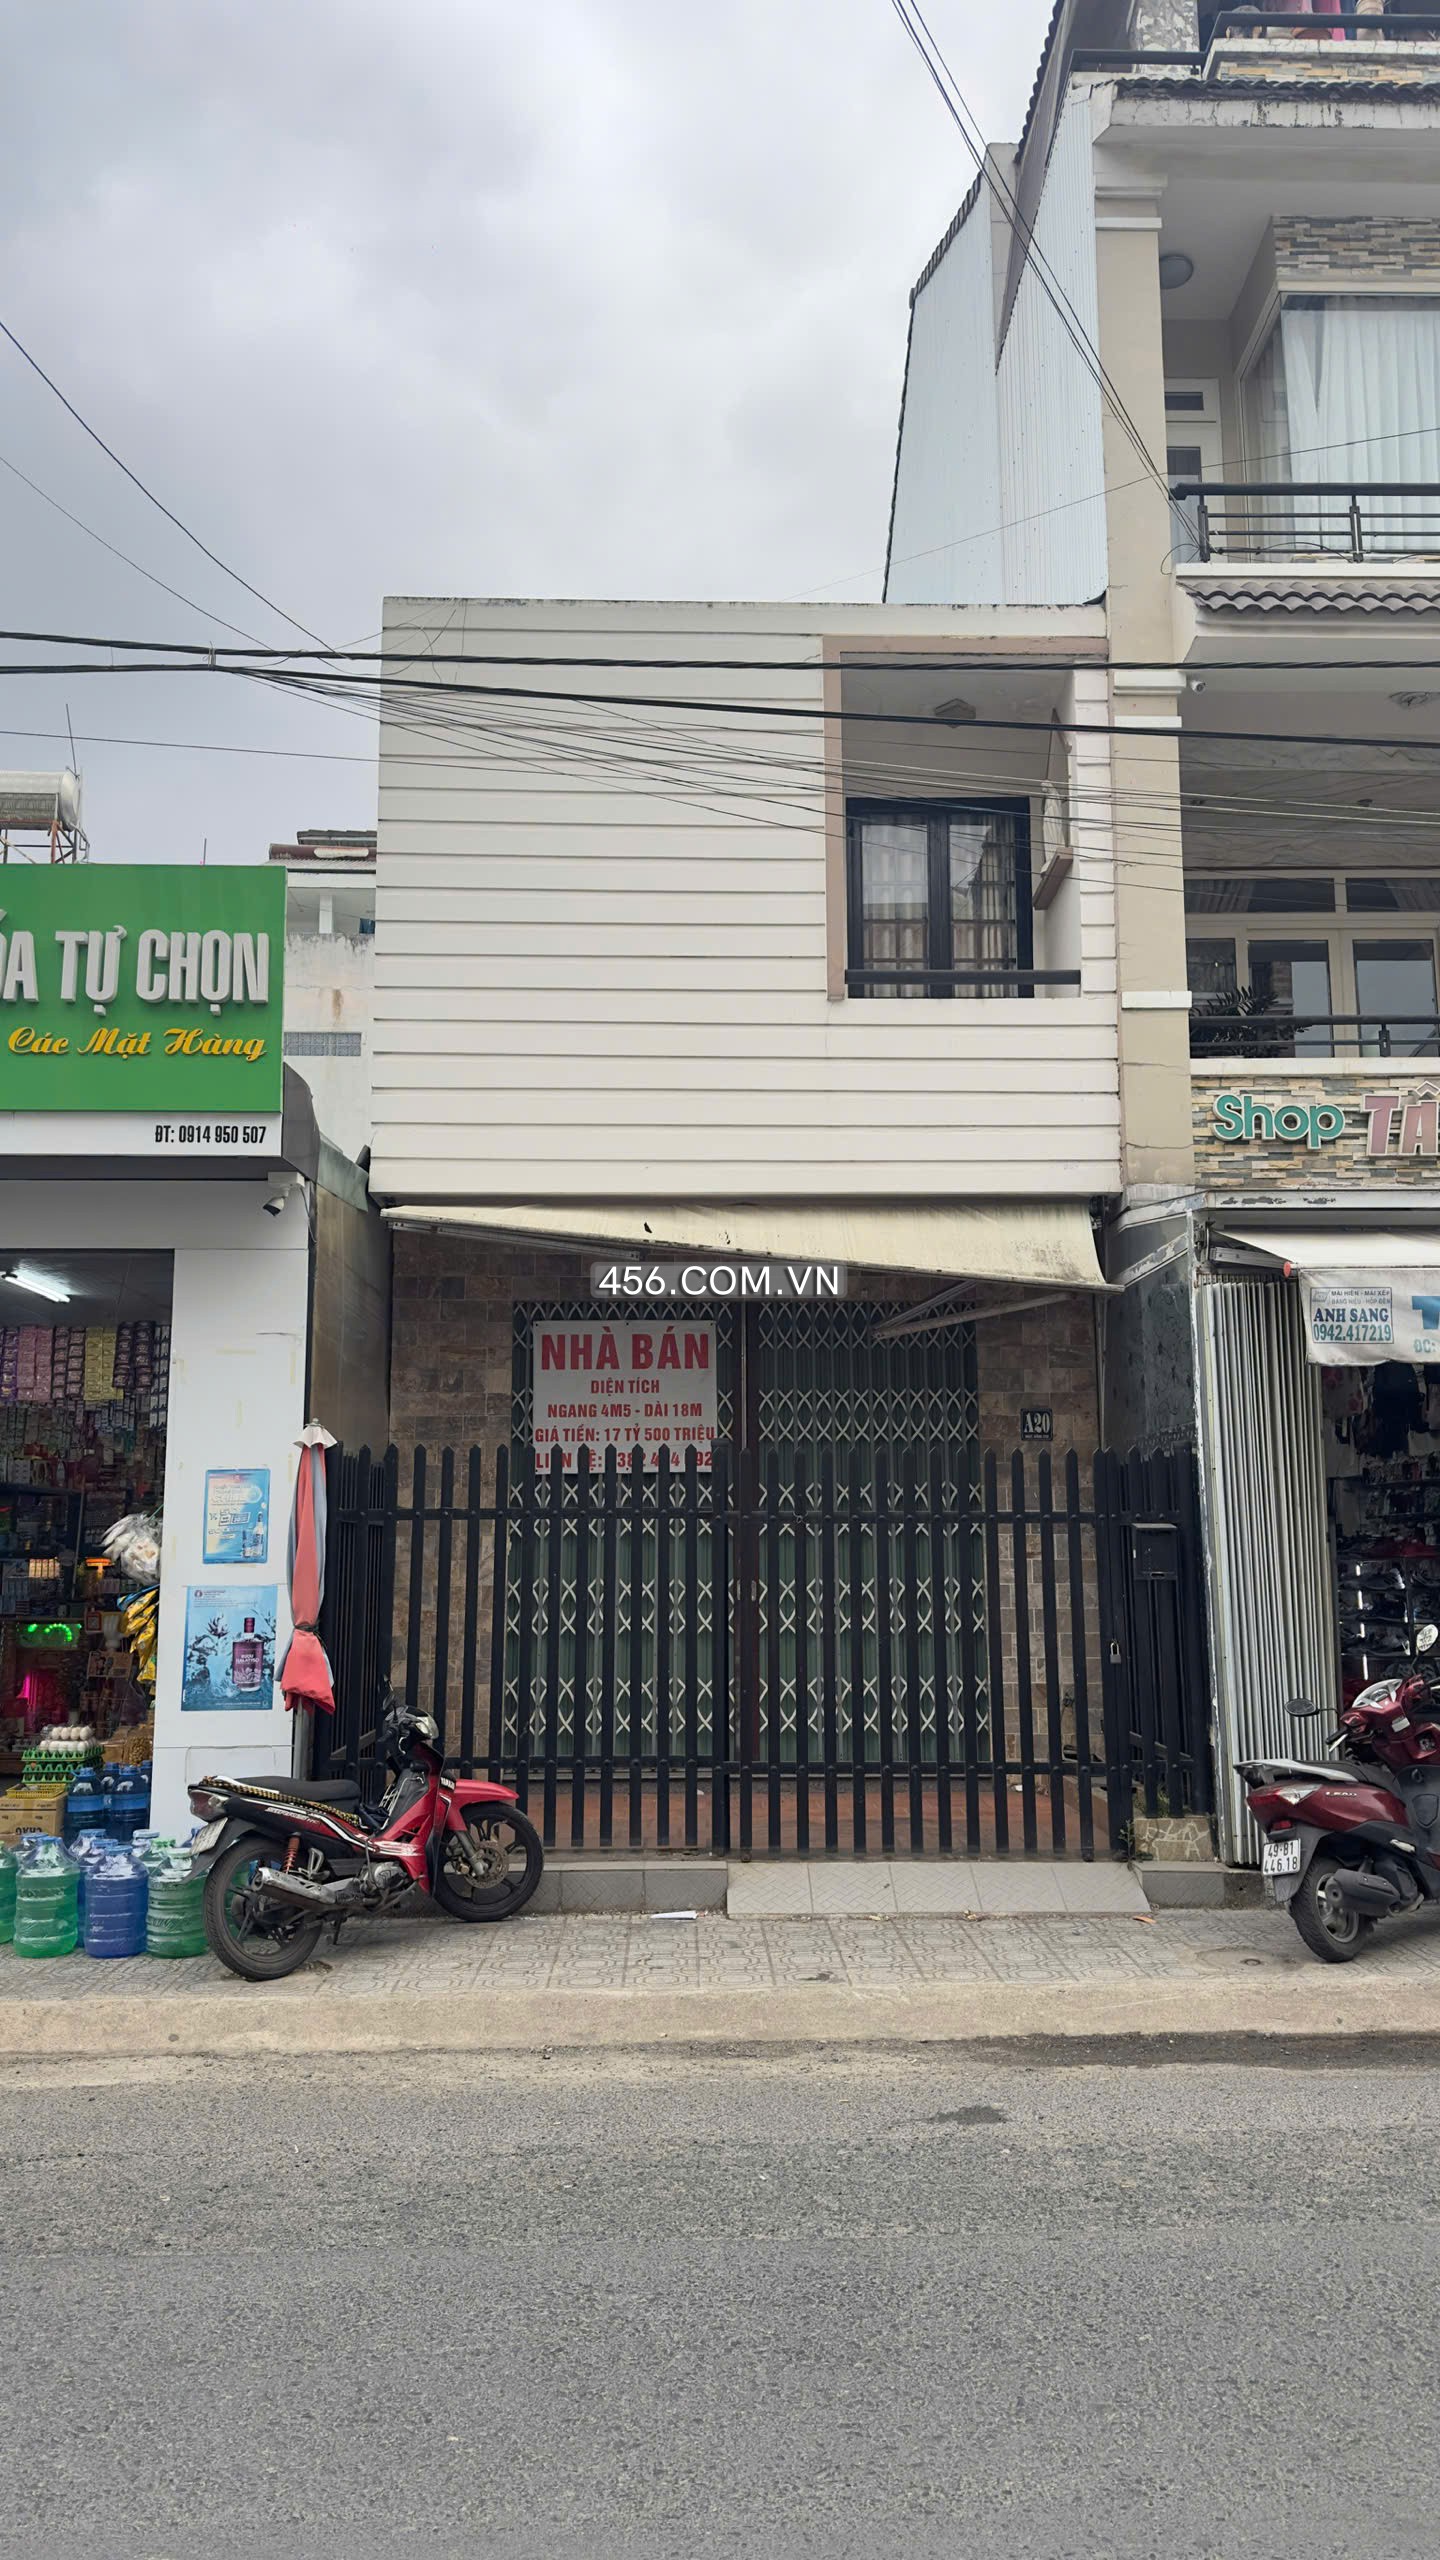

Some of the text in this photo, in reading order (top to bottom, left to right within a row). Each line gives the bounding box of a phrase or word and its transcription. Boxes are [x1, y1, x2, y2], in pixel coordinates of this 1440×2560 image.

[55, 924, 127, 1016] TỰ
[136, 929, 270, 1016] CHỌN
[8, 1027, 267, 1062] Các Mặt Hàng
[1212, 1094, 1346, 1150] Shop
[155, 1125, 266, 1143] ĐT: 0914 950 507
[1314, 1324, 1391, 1341] 0942.417219
[541, 1326, 709, 1370] NHÀ BÁN
[591, 1377, 660, 1396] DIỆN TÍCH
[548, 1404, 597, 1418] NGANG
[601, 1404, 631, 1417] 4M5
[644, 1401, 668, 1417] DÀI
[673, 1403, 702, 1417] 18M
[535, 1426, 559, 1442] GIÁ
[605, 1428, 620, 1441] 17
[625, 1422, 640, 1441] TỶ
[644, 1427, 670, 1441] 500
[674, 1424, 715, 1443] TRIỆU
[1024, 1412, 1051, 1434] A20
[536, 1452, 572, 1468] LIN
[1264, 1856, 1298, 1873] 446.18
